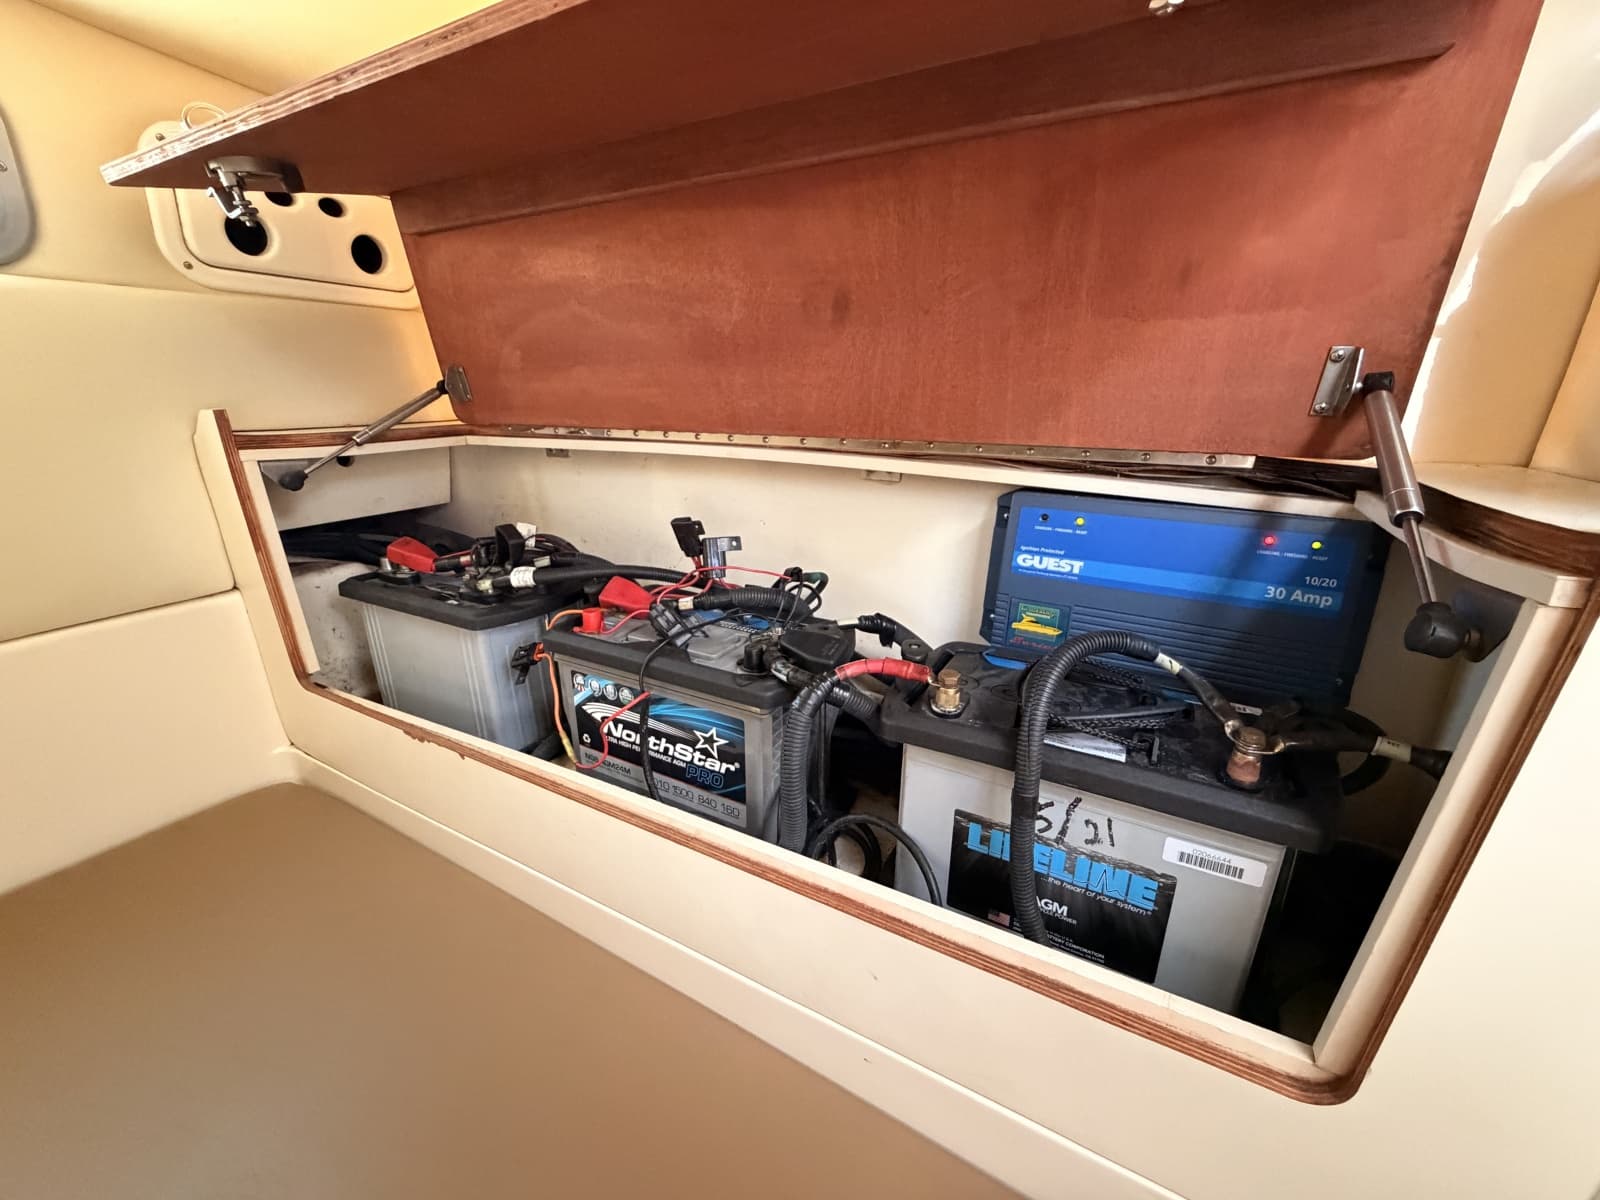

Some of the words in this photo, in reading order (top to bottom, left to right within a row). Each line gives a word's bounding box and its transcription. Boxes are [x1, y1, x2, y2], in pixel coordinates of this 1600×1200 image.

[1016, 553, 1084, 575] GUEST
[1304, 576, 1338, 588] 10/20
[1263, 585, 1286, 600] 30
[1290, 589, 1333, 609] Amp
[685, 763, 724, 789] PRO
[672, 785, 694, 801] 1500
[698, 794, 718, 809] 840
[721, 802, 741, 818] 160
[1062, 881, 1085, 894] heart
[1086, 889, 1096, 898] of
[1096, 894, 1115, 904] your
